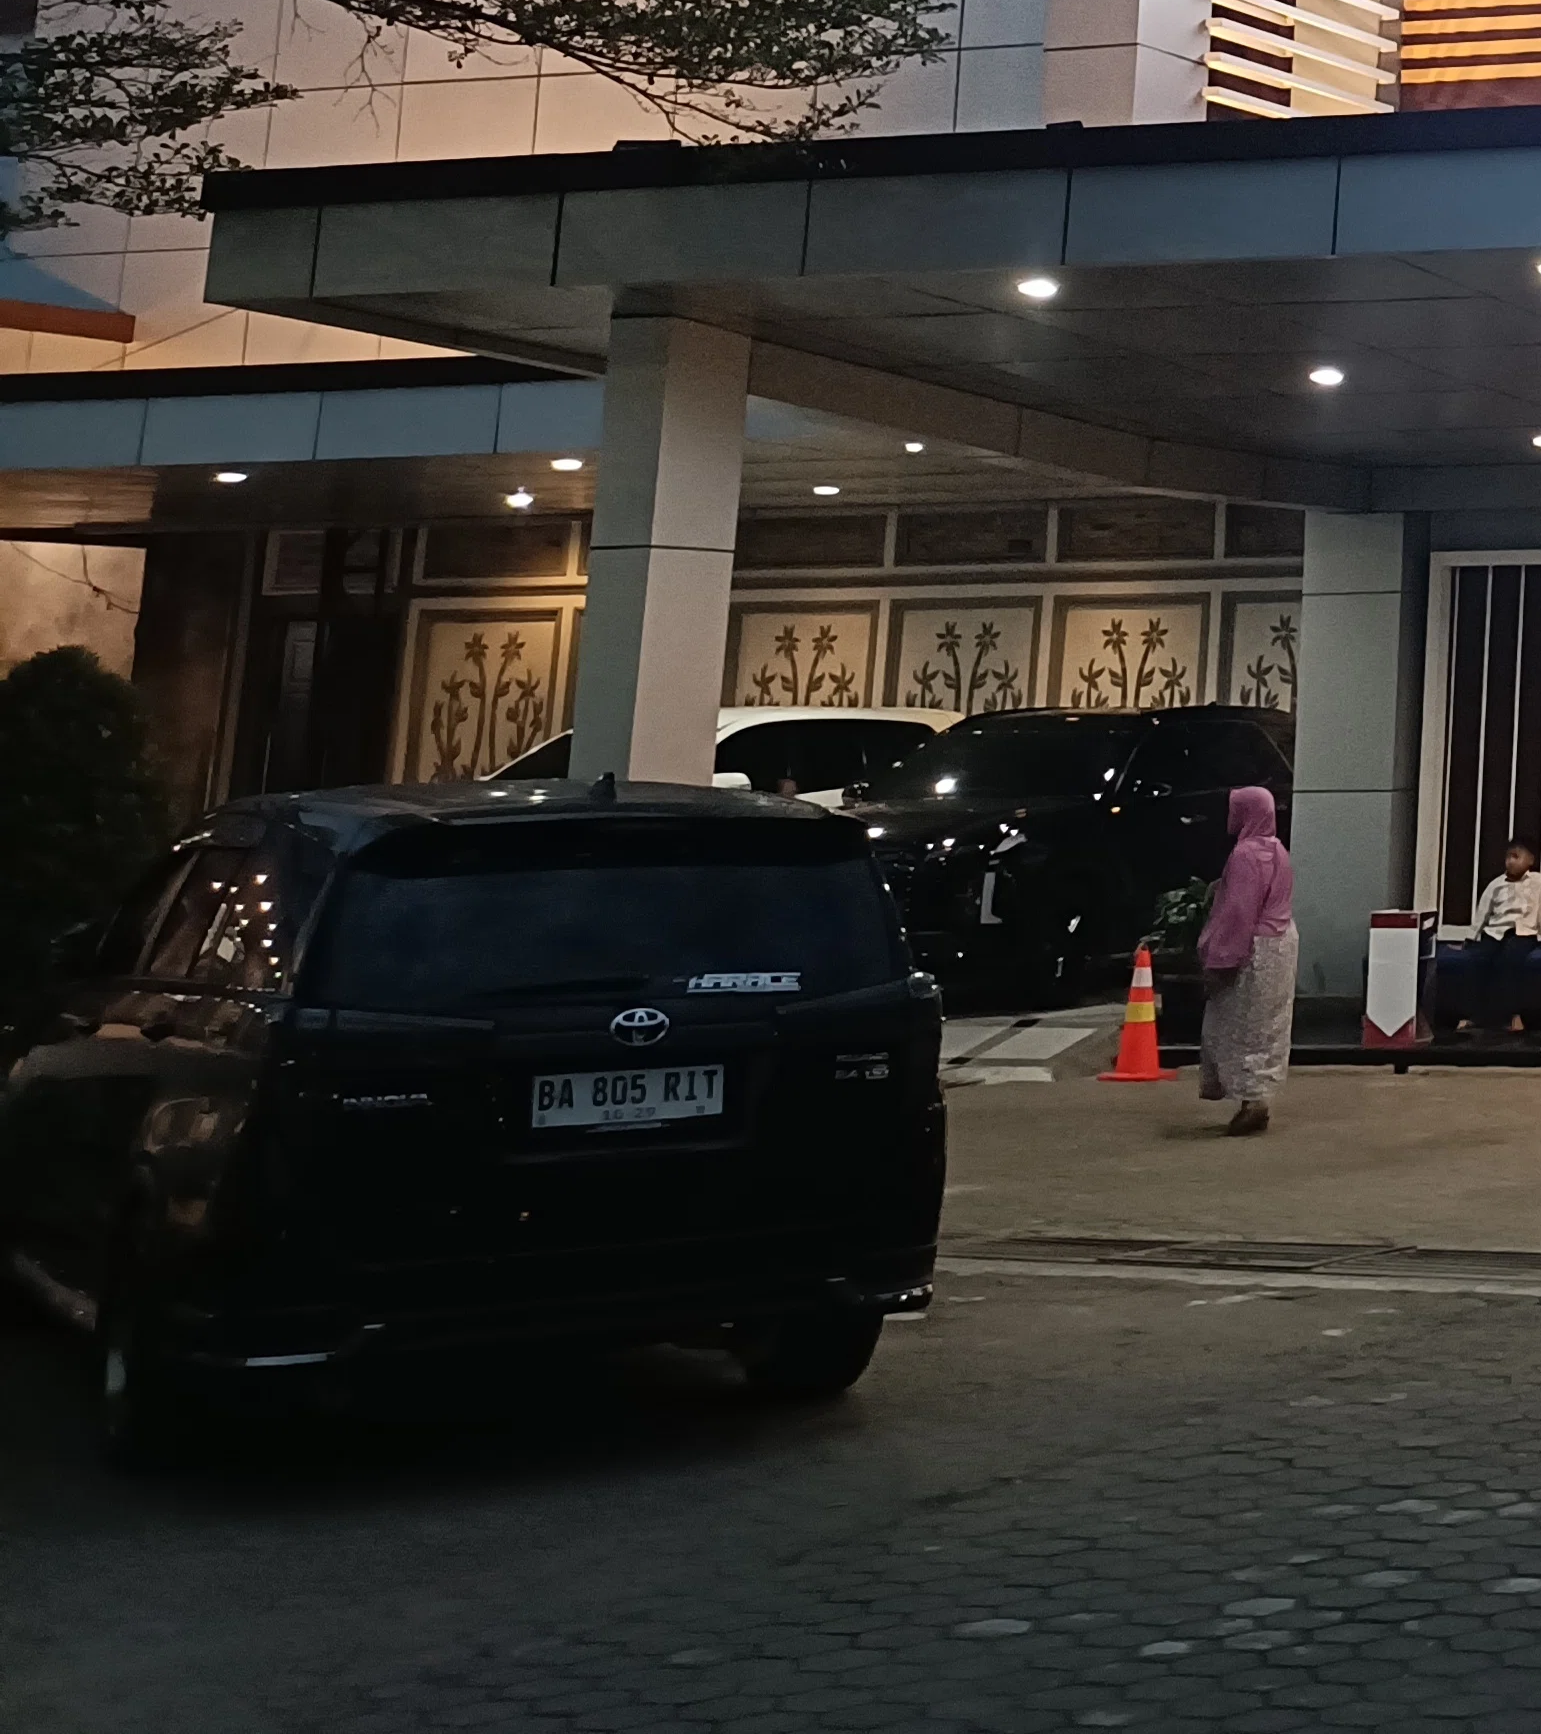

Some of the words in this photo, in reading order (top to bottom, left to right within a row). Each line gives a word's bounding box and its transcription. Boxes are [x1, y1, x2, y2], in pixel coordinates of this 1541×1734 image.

[538, 1078, 574, 1111] BA
[592, 1074, 647, 1107] 805
[663, 1069, 718, 1102] RIT
